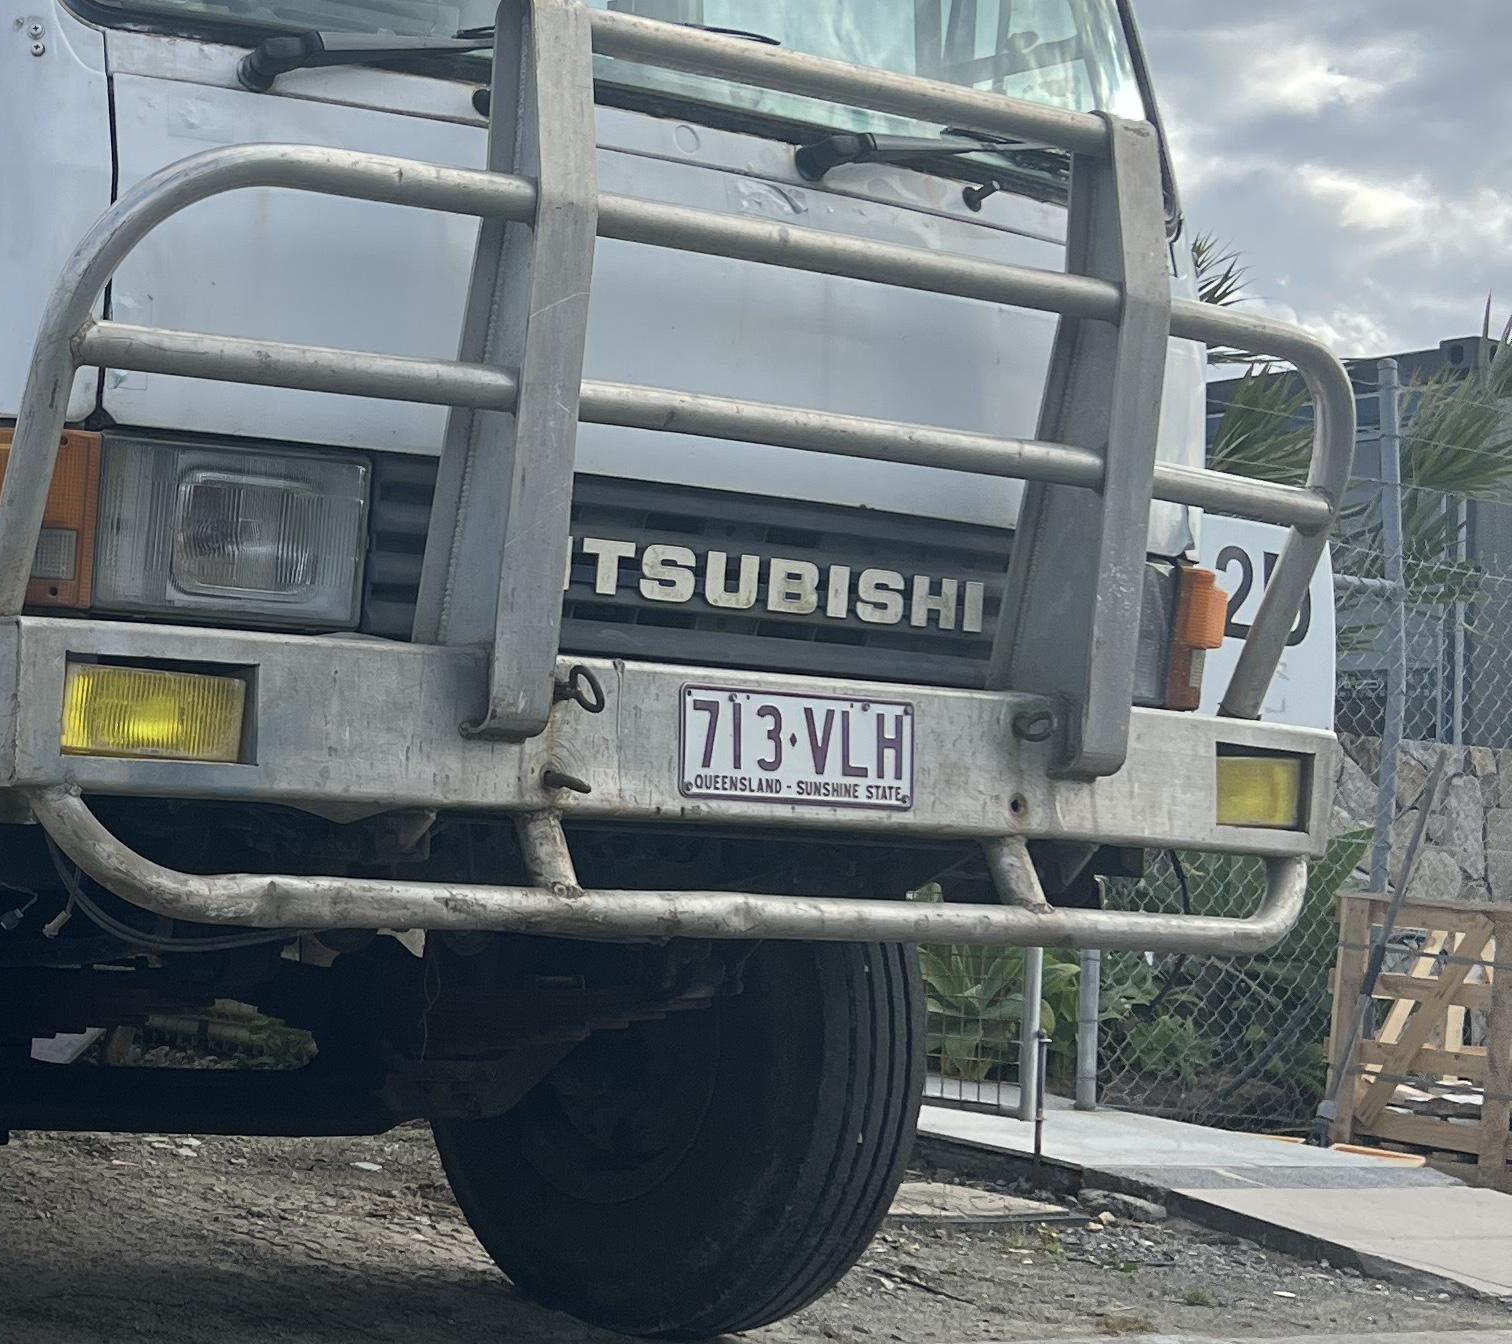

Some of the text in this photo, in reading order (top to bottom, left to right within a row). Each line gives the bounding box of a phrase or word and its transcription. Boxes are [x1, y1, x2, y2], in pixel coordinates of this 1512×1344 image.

[563, 535, 985, 633] TSUBISHI
[694, 773, 782, 794] QUEENSLAND
[796, 780, 860, 799] SUNSHINE
[865, 784, 902, 802] STATE
